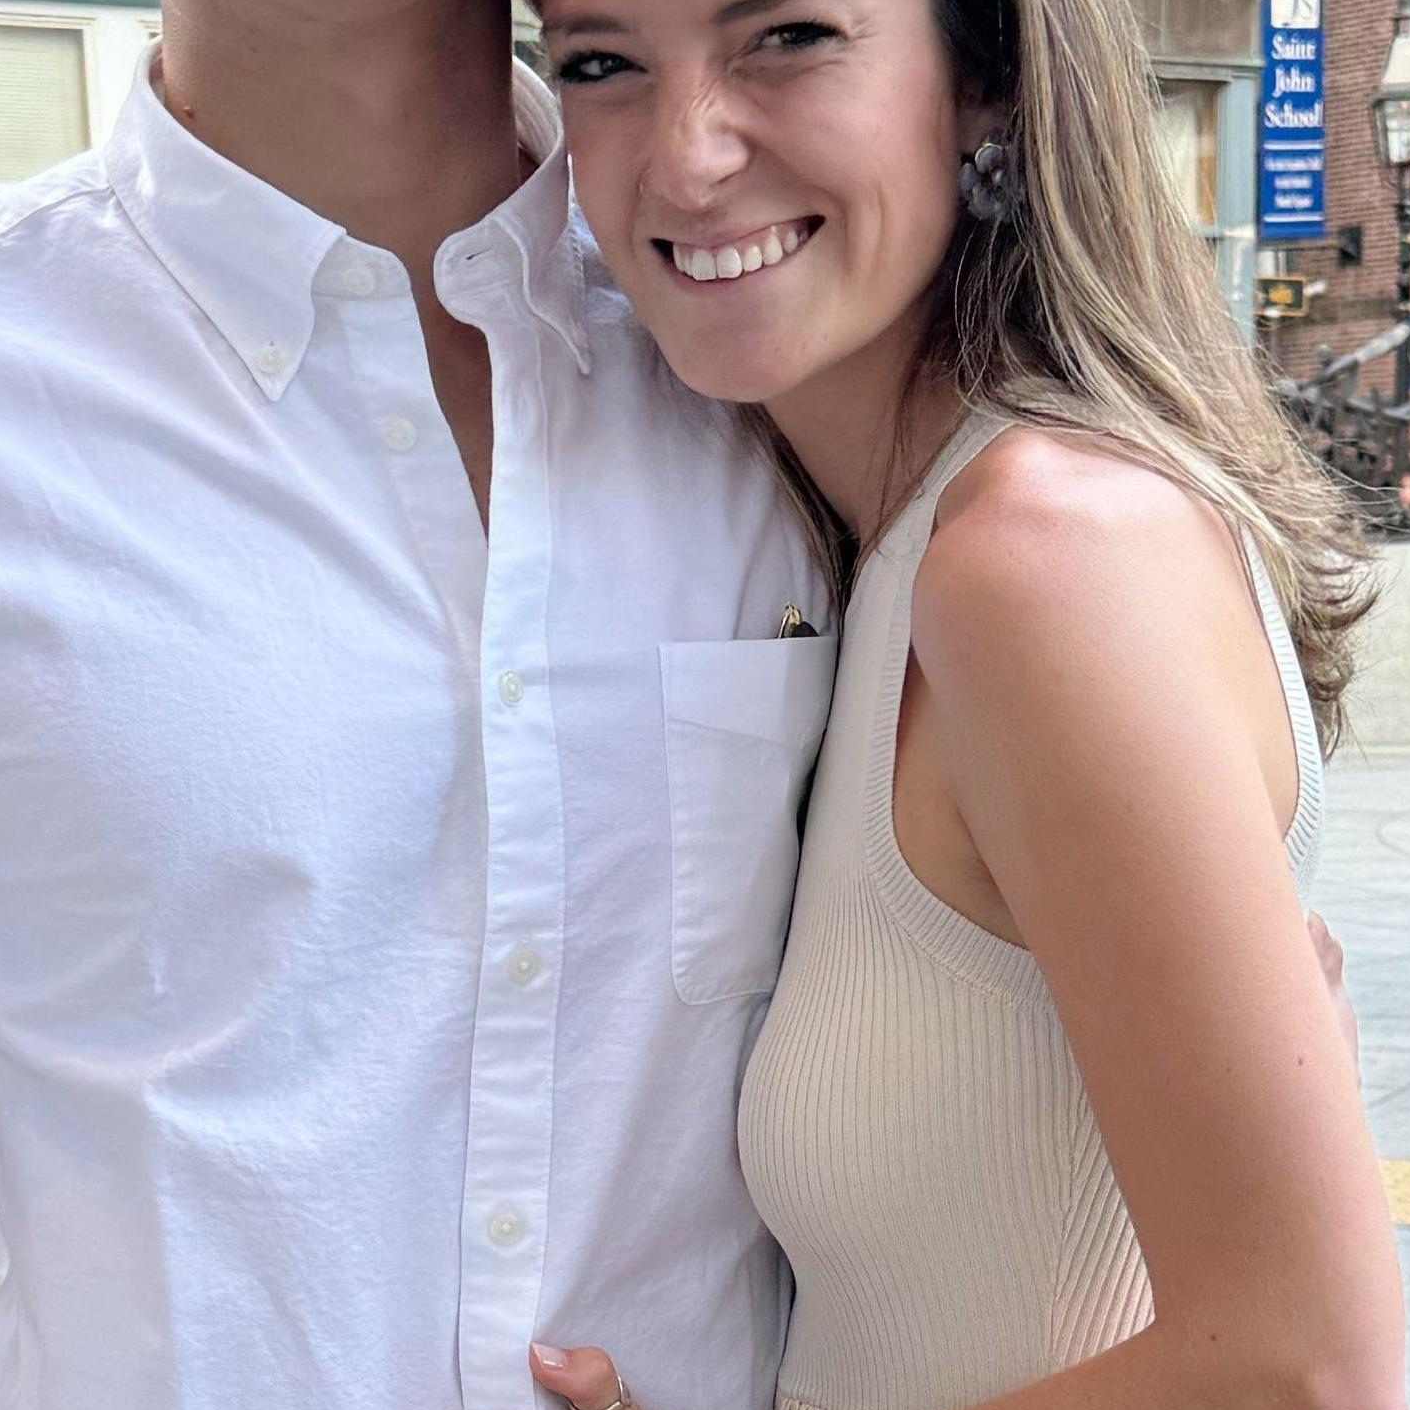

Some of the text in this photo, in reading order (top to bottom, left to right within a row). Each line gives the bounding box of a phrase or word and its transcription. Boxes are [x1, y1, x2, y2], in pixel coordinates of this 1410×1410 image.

[1271, 32, 1316, 61] Saint
[1271, 64, 1315, 98] John
[1263, 99, 1324, 129] School
